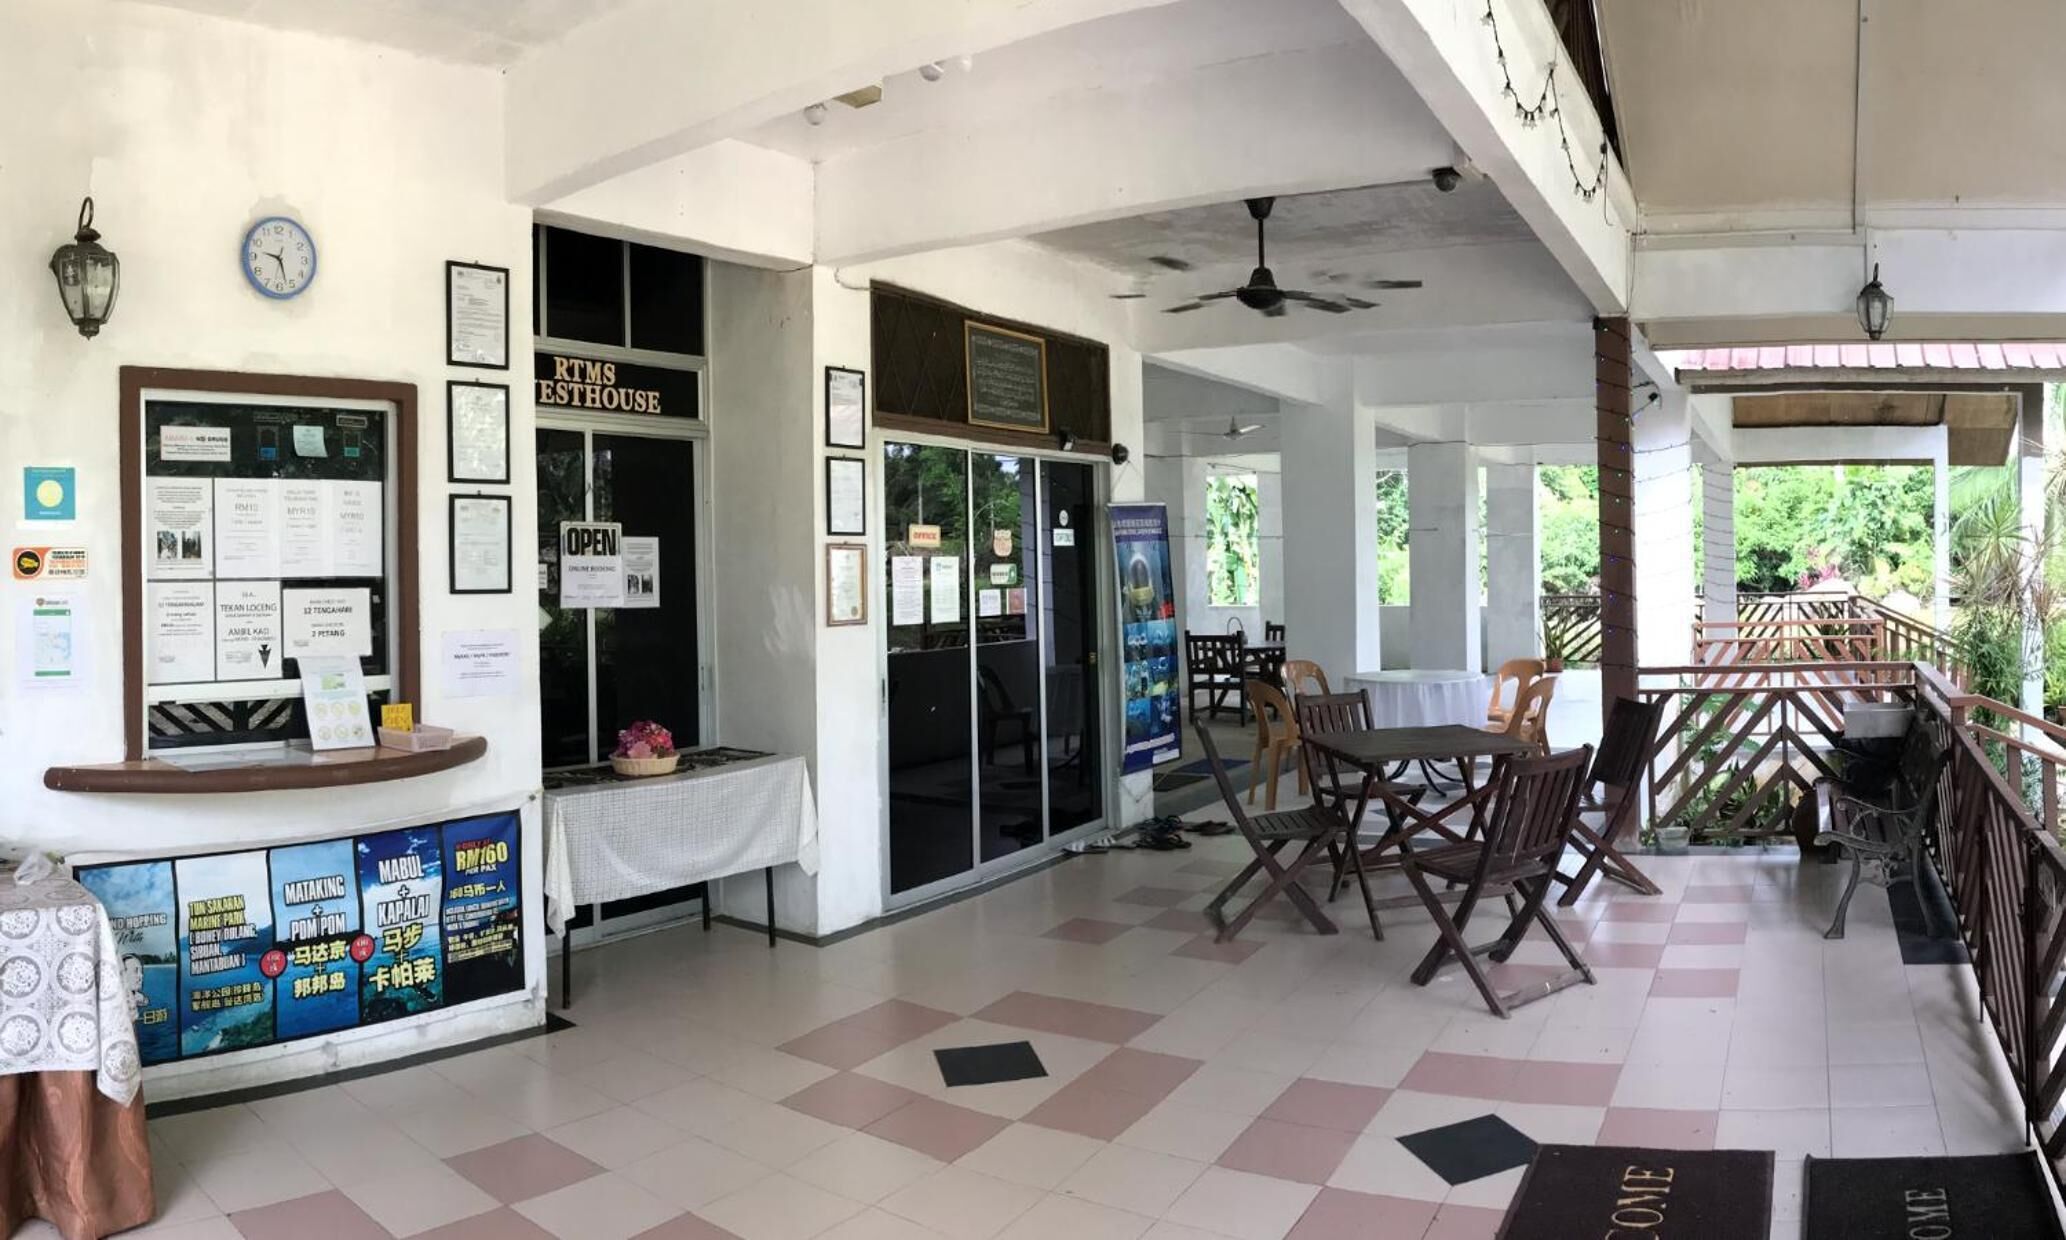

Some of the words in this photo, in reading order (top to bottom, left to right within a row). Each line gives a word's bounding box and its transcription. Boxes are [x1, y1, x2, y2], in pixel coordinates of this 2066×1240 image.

[262, 227, 271, 236] 11
[274, 225, 284, 235] 12
[253, 238, 263, 248] 10
[297, 241, 304, 251] 2
[301, 255, 308, 265] 3
[254, 266, 262, 276] 8
[264, 277, 271, 288] 7
[276, 281, 284, 291] 6
[288, 279, 296, 288] 5
[554, 356, 616, 386] RTMS
[535, 379, 661, 414] ESTHOUSE
[567, 527, 616, 556] OPEN
[220, 603, 244, 612] TEKAN
[456, 841, 508, 872] RM160
[379, 855, 424, 884] MABUL
[480, 863, 497, 873] PAX
[285, 875, 345, 905] MATAKING
[190, 901, 205, 916] TUN
[207, 895, 245, 913] SAKARAN
[378, 895, 430, 927] KAPALAI
[108, 917, 124, 931] ND
[126, 912, 166, 929] HOPPING
[190, 916, 222, 930] MARINE
[223, 910, 245, 927] PARK
[291, 918, 317, 941] POM
[320, 913, 346, 937] POM
[383, 923, 423, 951] 马步
[294, 940, 346, 965] 马达京
[369, 957, 435, 991] 卡帕莱
[293, 971, 345, 999] 邦邦岛
